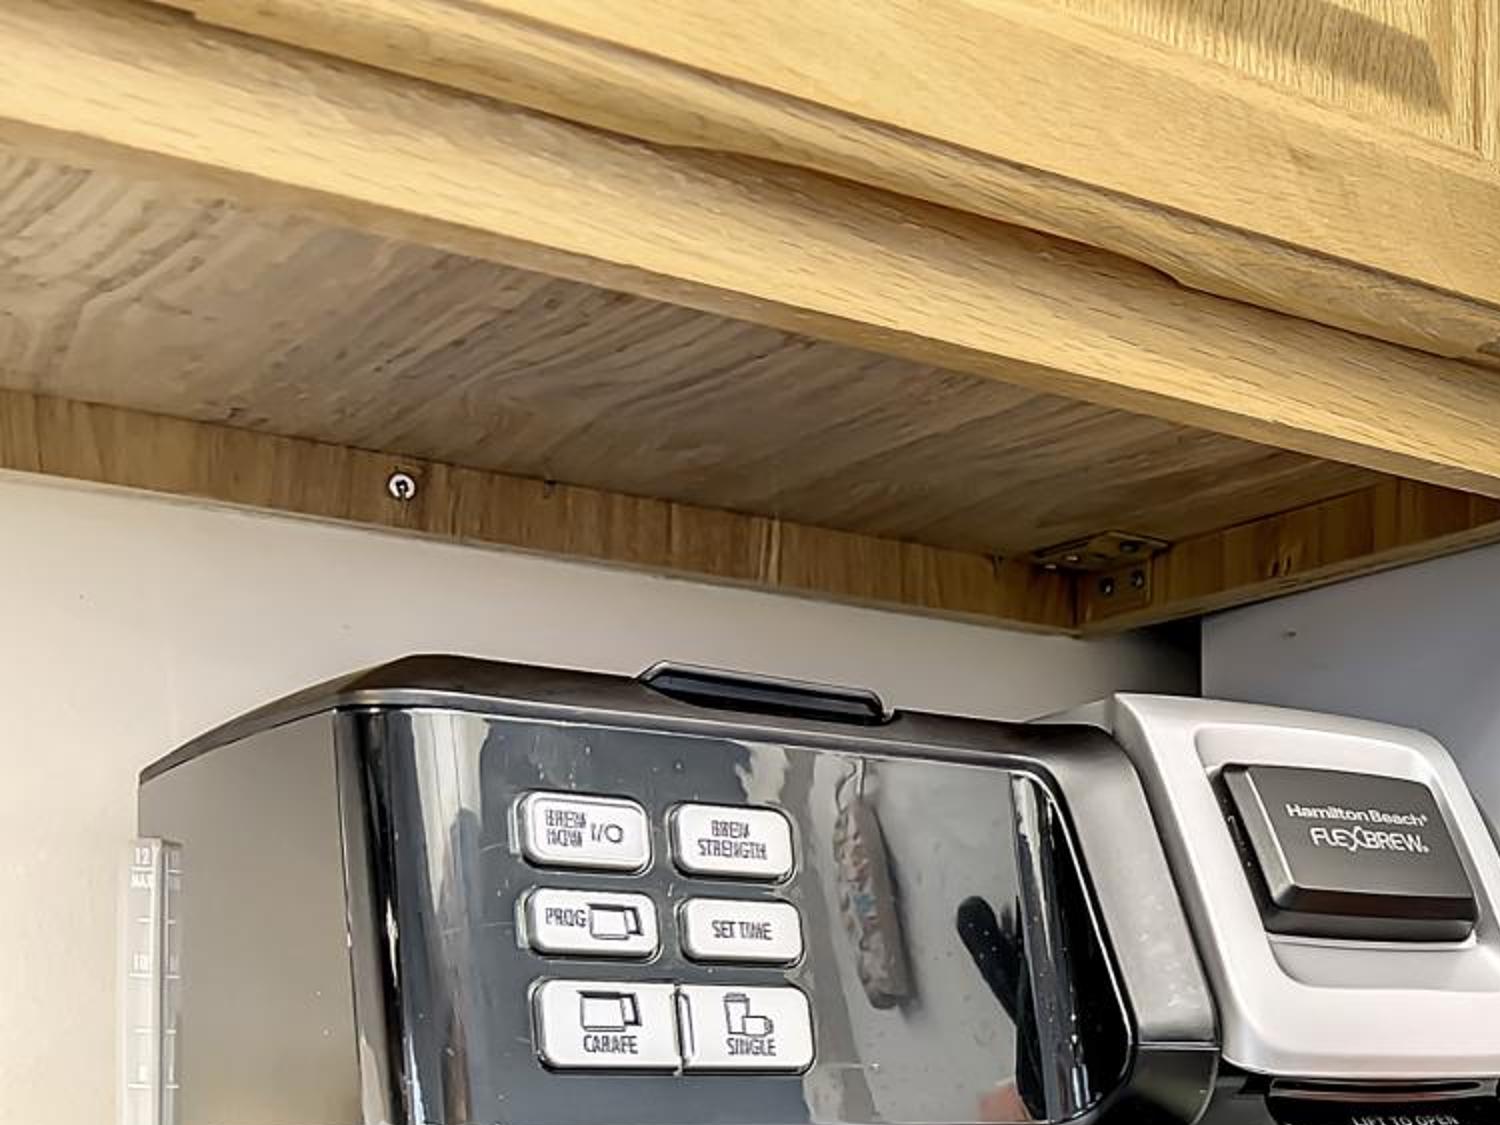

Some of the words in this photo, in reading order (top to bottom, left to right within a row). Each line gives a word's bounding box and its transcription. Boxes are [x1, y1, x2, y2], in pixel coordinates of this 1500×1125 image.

[1285, 804, 1368, 822] Hamilton
[697, 839, 768, 860] STRENGTH
[545, 907, 587, 928] PROG
[712, 920, 737, 938] SET
[738, 922, 774, 940] TIME
[583, 1035, 639, 1055] CARAFE
[726, 1038, 777, 1057] SINGLE
